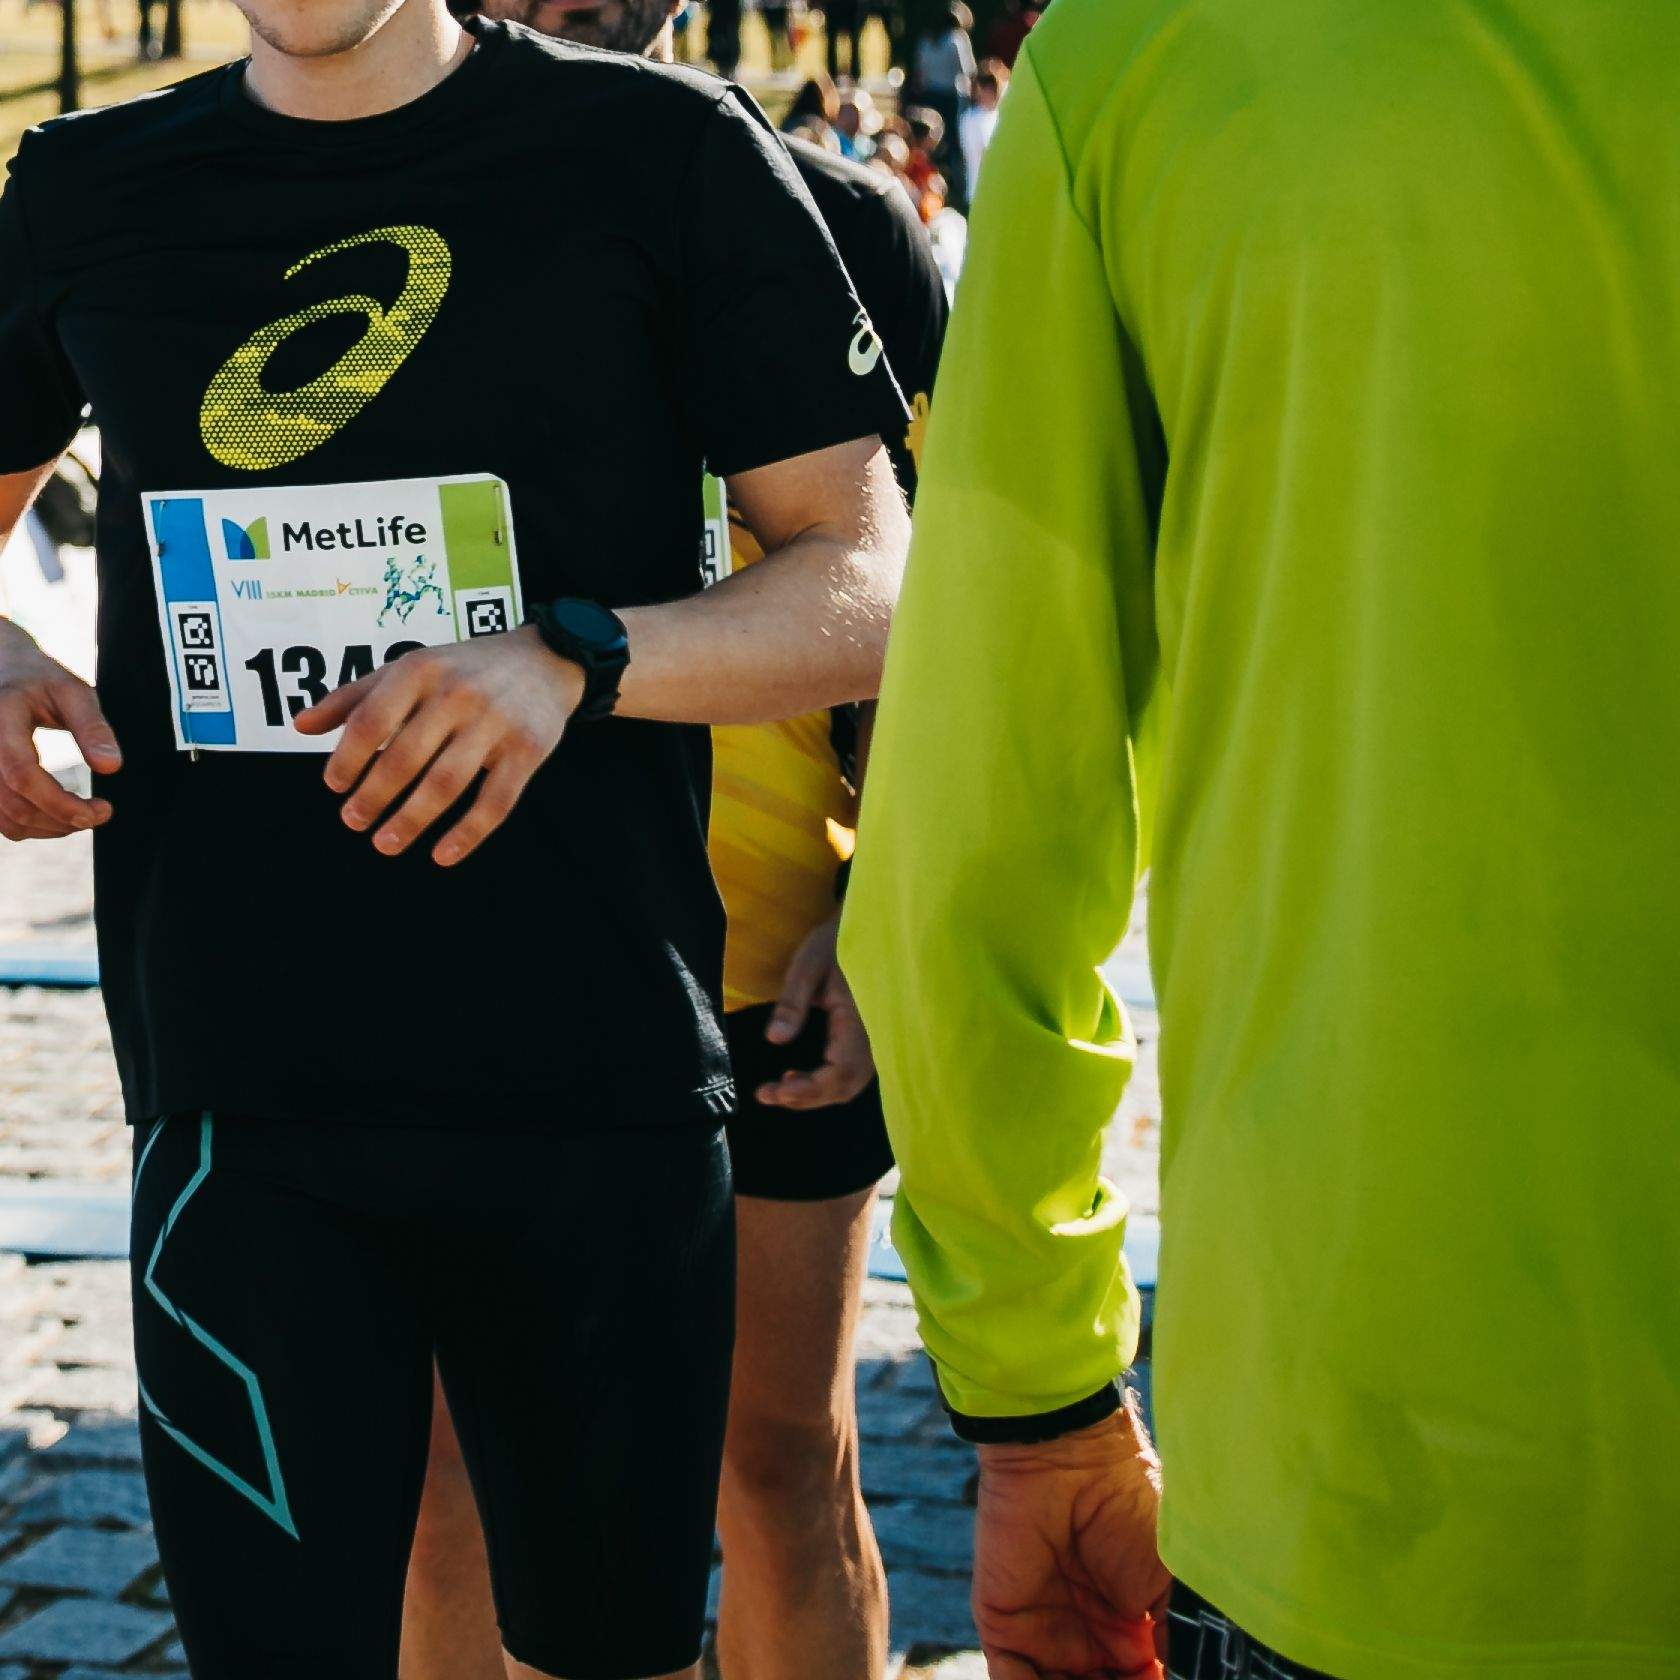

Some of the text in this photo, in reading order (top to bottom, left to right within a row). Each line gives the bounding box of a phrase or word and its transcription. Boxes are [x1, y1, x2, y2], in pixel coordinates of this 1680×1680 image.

[282, 515, 427, 551] MetLife
[231, 579, 263, 600] VIII
[244, 640, 427, 727] 134
